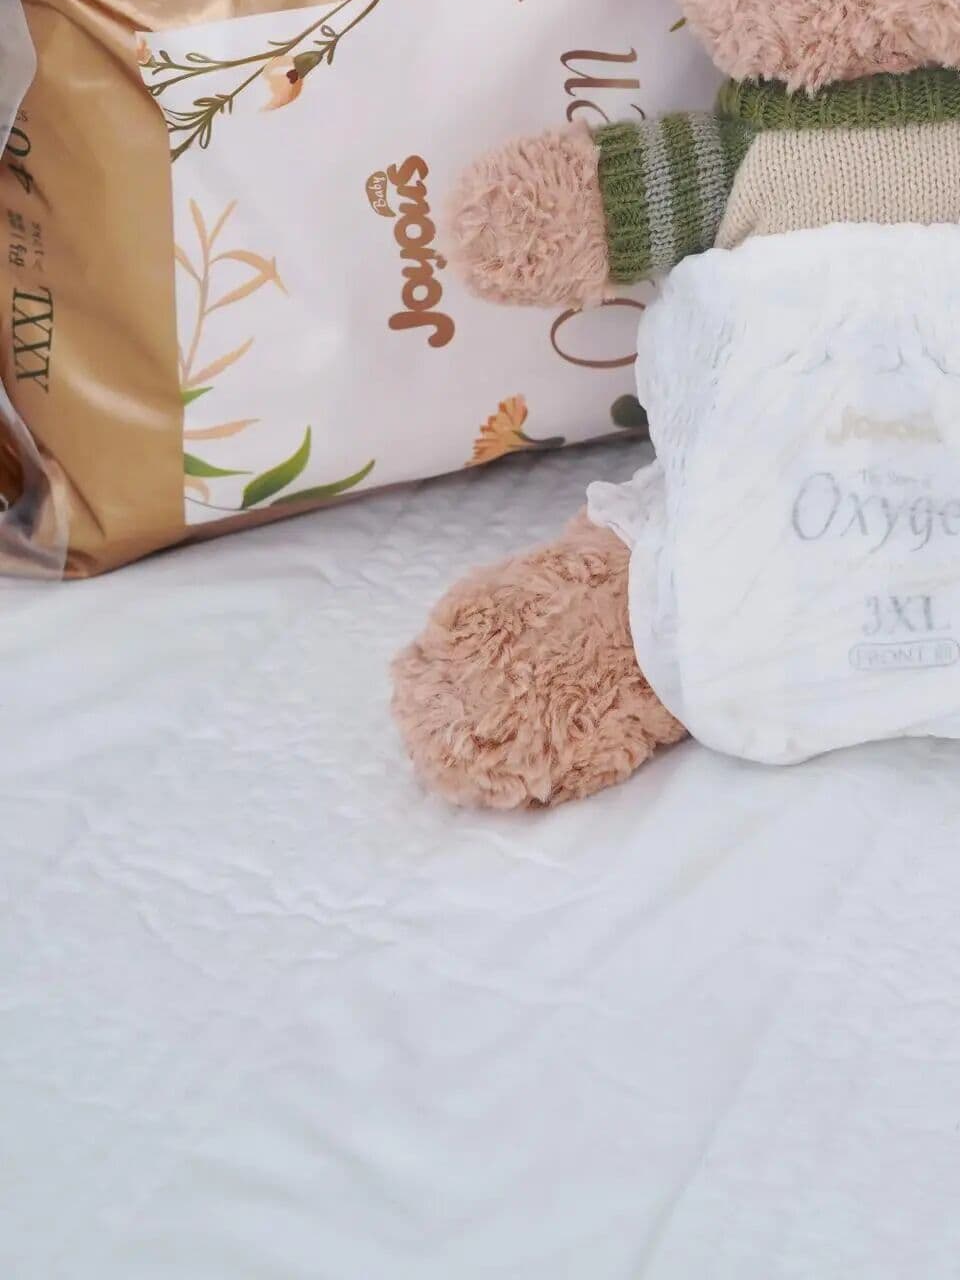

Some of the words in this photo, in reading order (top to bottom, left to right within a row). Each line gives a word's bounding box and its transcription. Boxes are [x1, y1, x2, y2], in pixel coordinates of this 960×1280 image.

[370, 176, 387, 210] Baby
[387, 155, 456, 348] Joyous
[12, 285, 54, 395] XXXL
